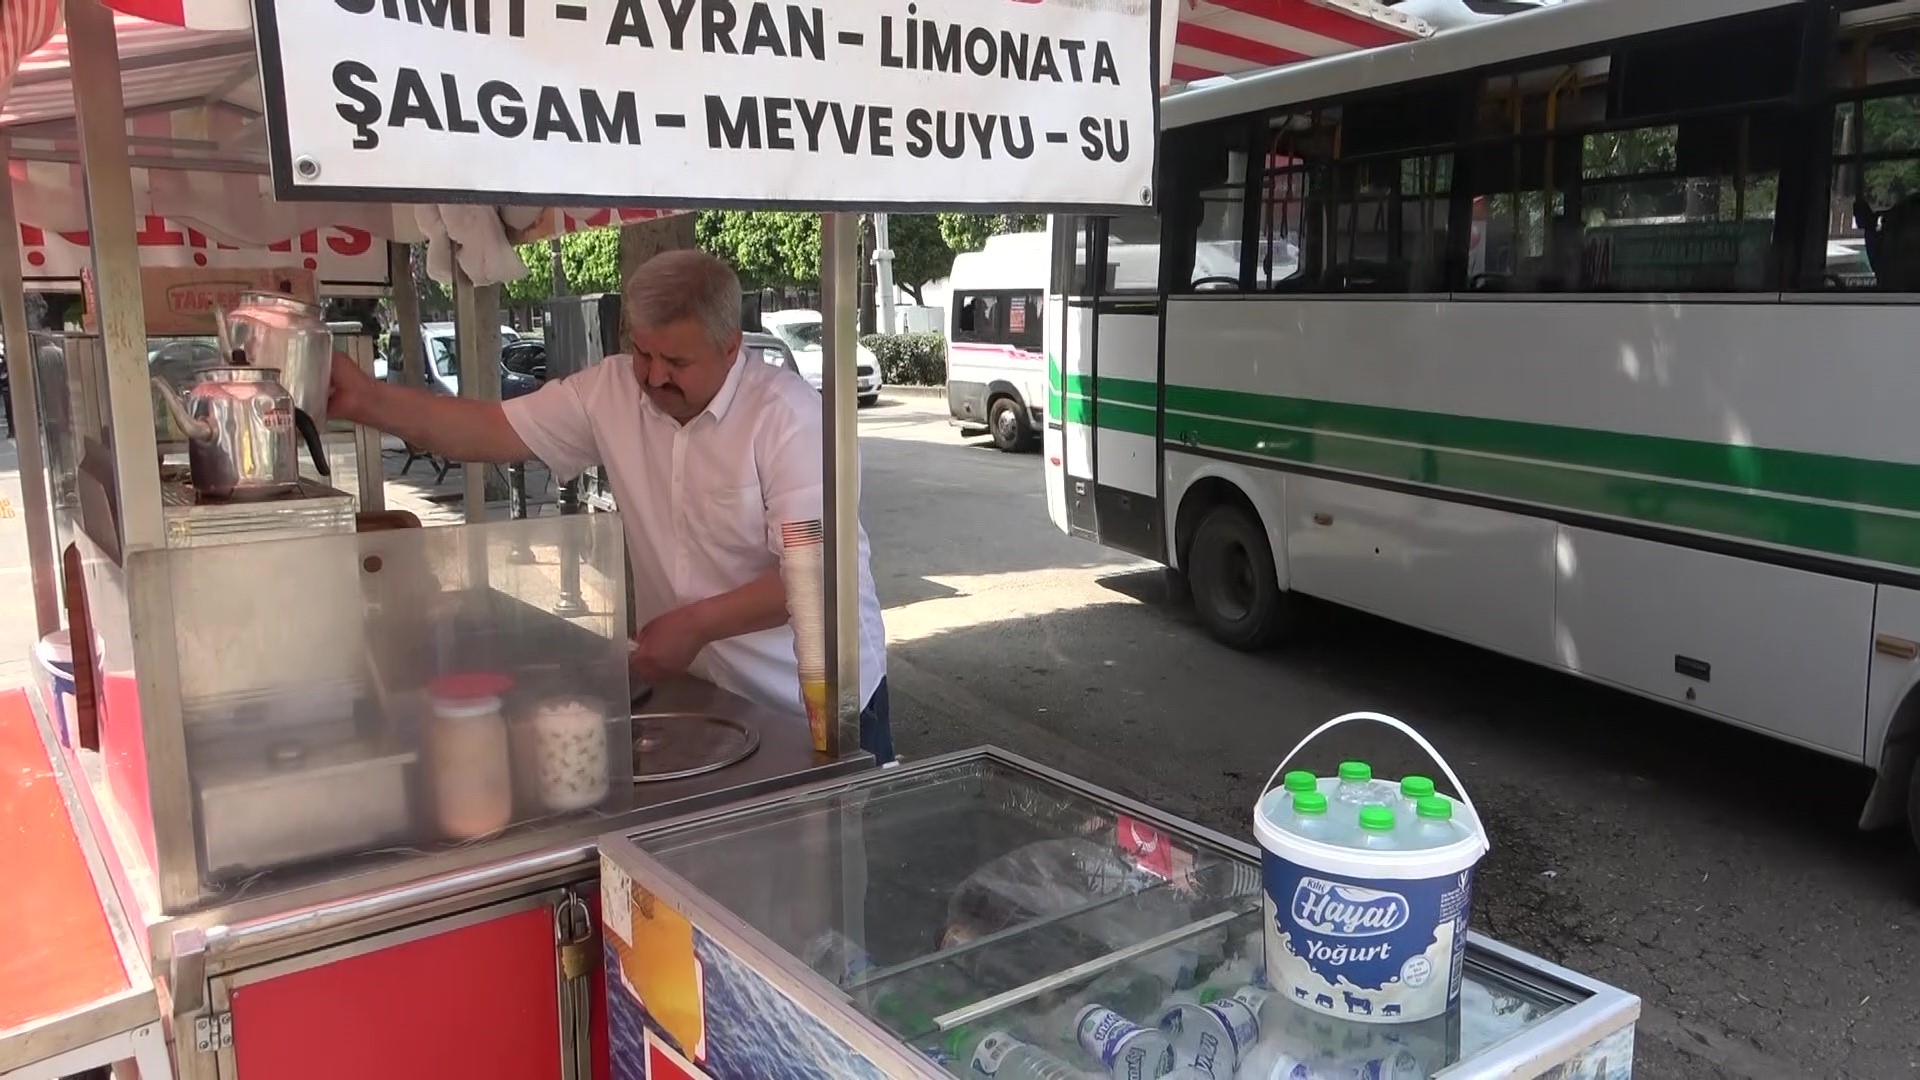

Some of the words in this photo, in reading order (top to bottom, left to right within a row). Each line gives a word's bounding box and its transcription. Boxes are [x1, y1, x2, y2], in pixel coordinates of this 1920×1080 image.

[605, 0, 826, 61] AYRAN
[880, 3, 1120, 86] LİMONATA
[332, 60, 641, 150] ŞALGAM
[704, 94, 895, 157] MEYVE
[906, 108, 1035, 160] SUYU
[1079, 116, 1129, 163] SU
[1301, 891, 1399, 933] Hayat
[1306, 939, 1393, 965] Yoğurt
